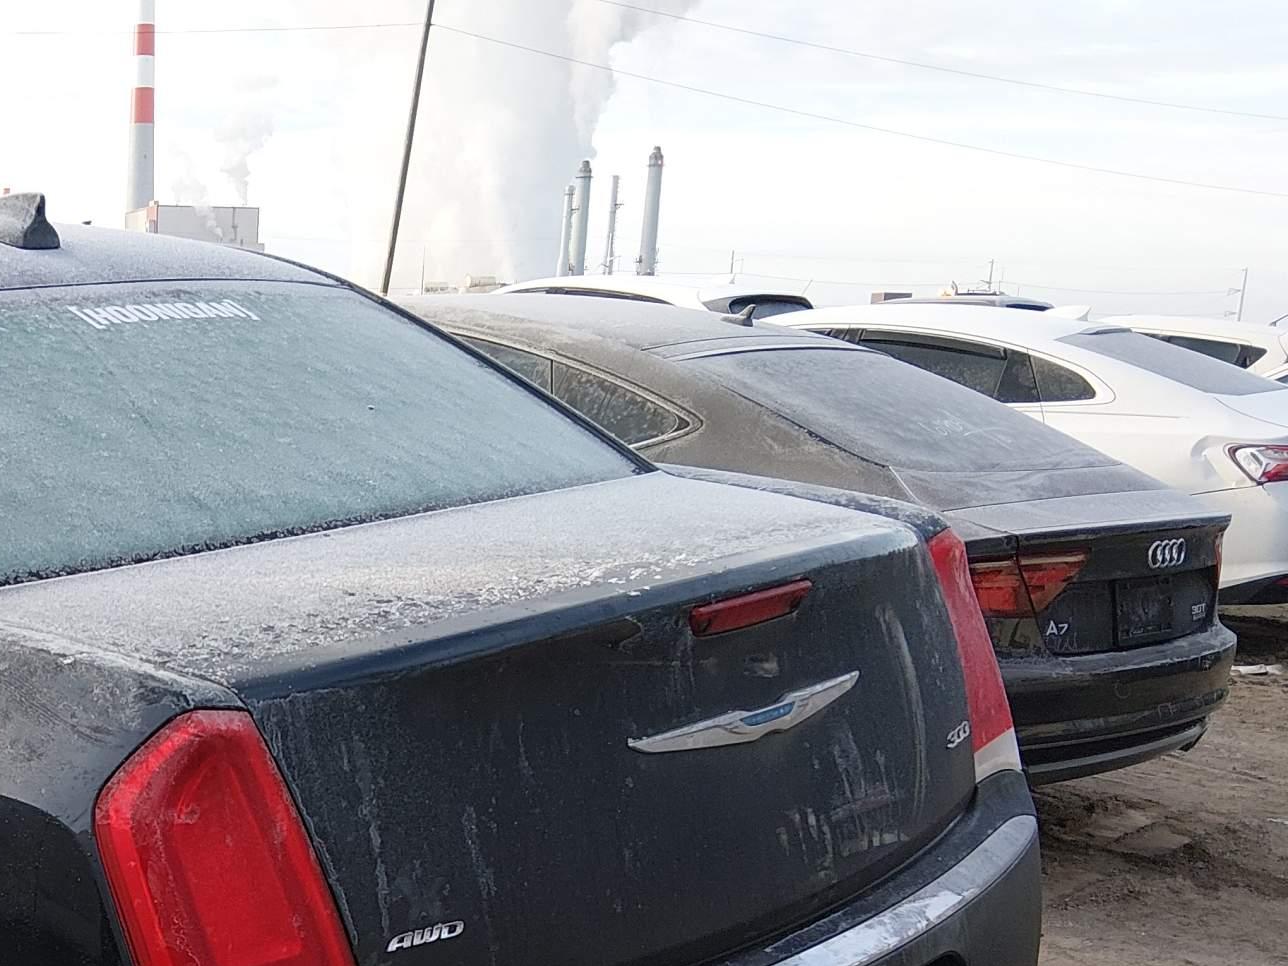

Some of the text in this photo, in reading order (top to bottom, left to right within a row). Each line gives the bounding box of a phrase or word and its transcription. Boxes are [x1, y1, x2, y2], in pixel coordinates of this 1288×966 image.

[1046, 620, 1068, 636] A7
[947, 721, 970, 748] 300
[386, 920, 465, 953] AWD
